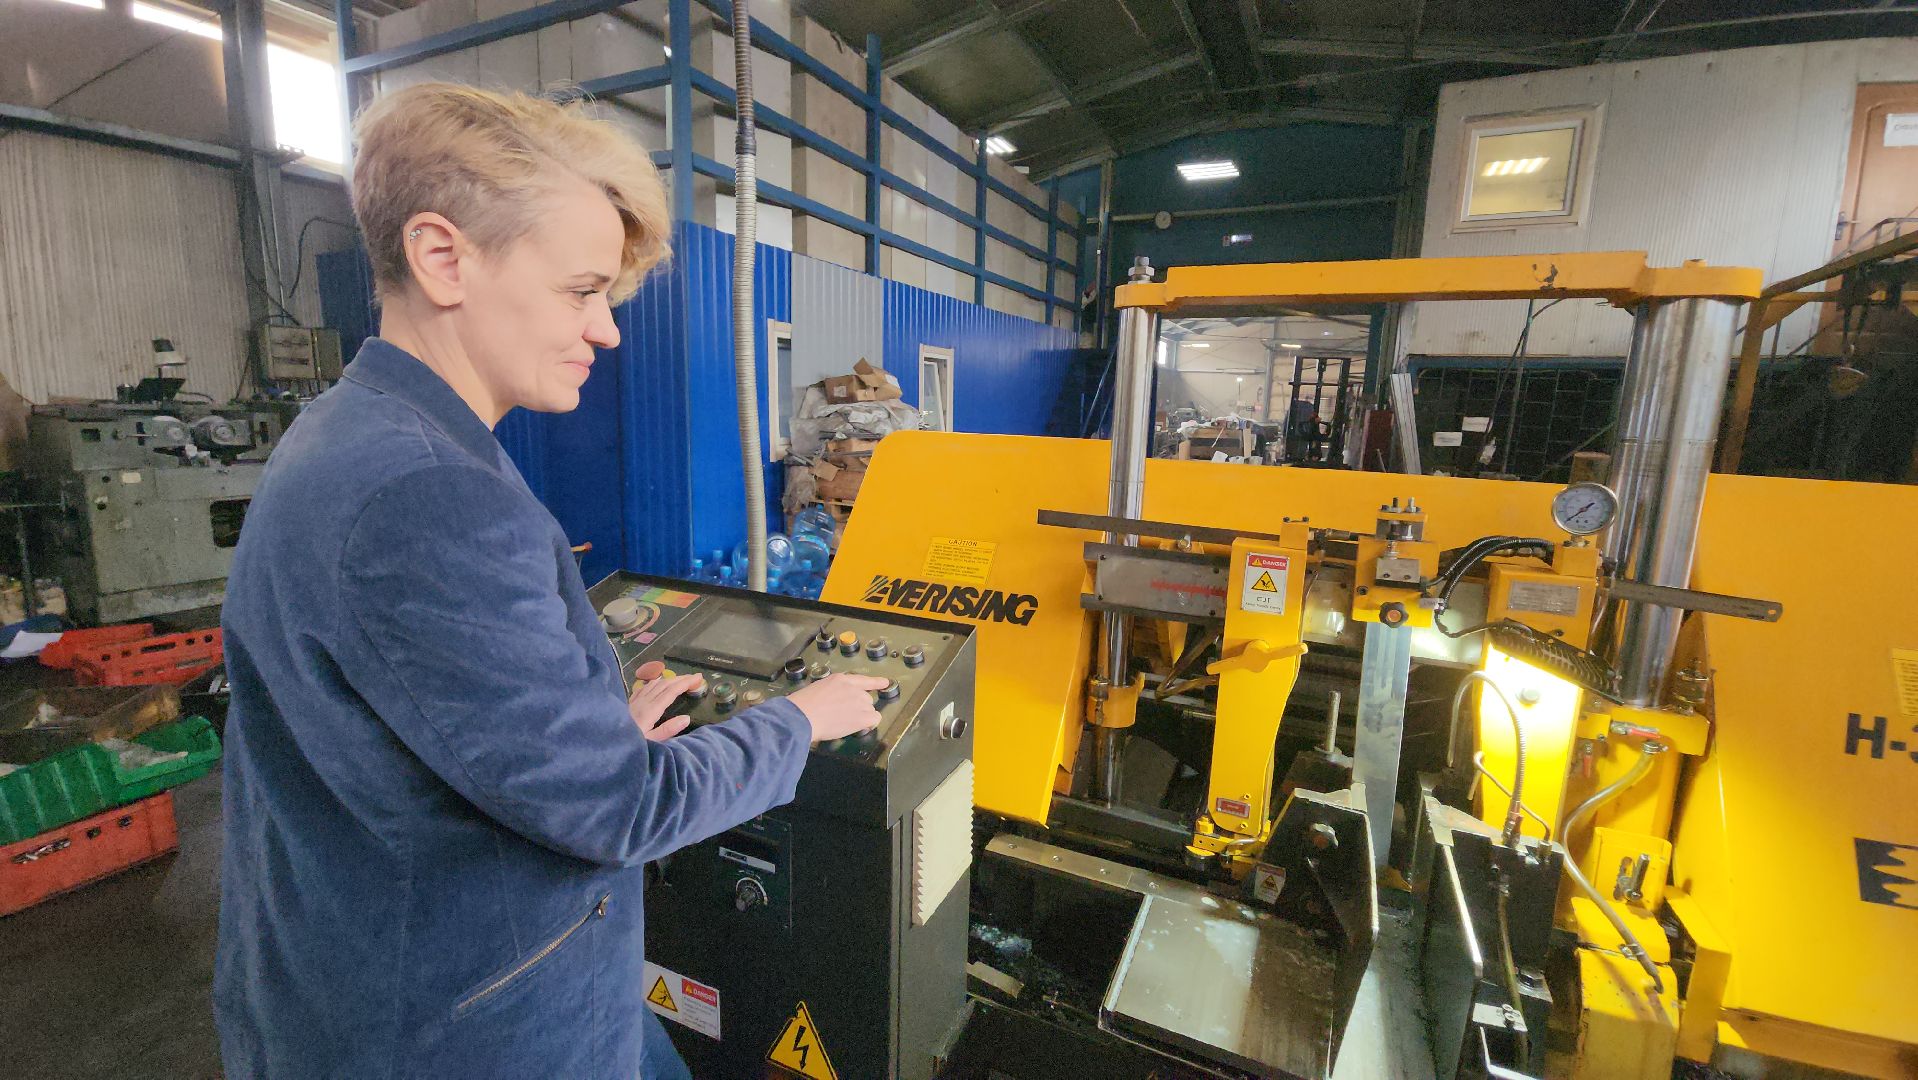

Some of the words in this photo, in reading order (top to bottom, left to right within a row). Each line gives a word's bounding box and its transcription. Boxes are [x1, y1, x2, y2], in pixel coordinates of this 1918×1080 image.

[948, 539, 978, 547] CAUTION
[1262, 559, 1287, 567] DANGER
[693, 988, 717, 1003] DANGER
